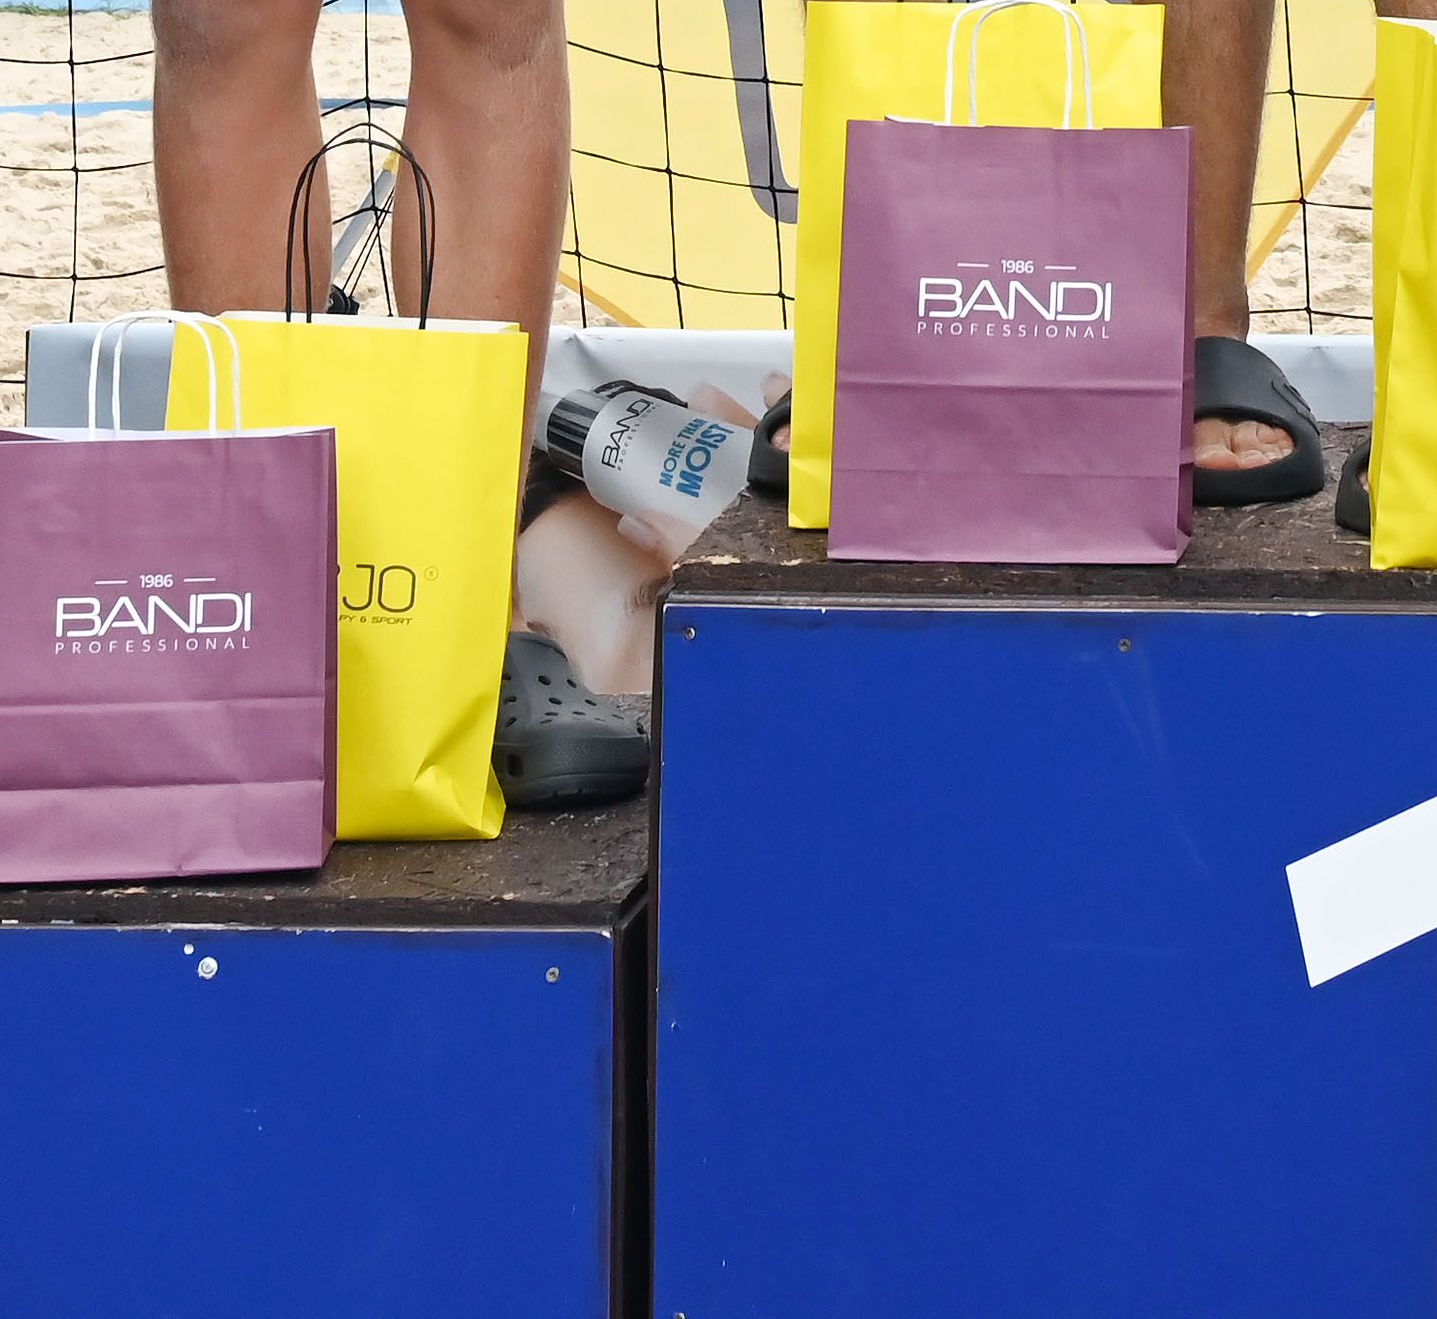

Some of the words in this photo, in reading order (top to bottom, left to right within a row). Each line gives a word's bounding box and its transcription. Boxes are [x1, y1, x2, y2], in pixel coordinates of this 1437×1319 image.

[1000, 259, 1035, 275] 1986
[917, 277, 1112, 322] BANDI
[917, 320, 1111, 340] PROFESSIONAL
[659, 439, 687, 488] MORE
[677, 417, 708, 440] THAN
[675, 423, 735, 499] MOIST
[138, 572, 174, 590] 1986
[55, 592, 252, 639] BANDI
[54, 637, 252, 655] PROFESSIONAL
